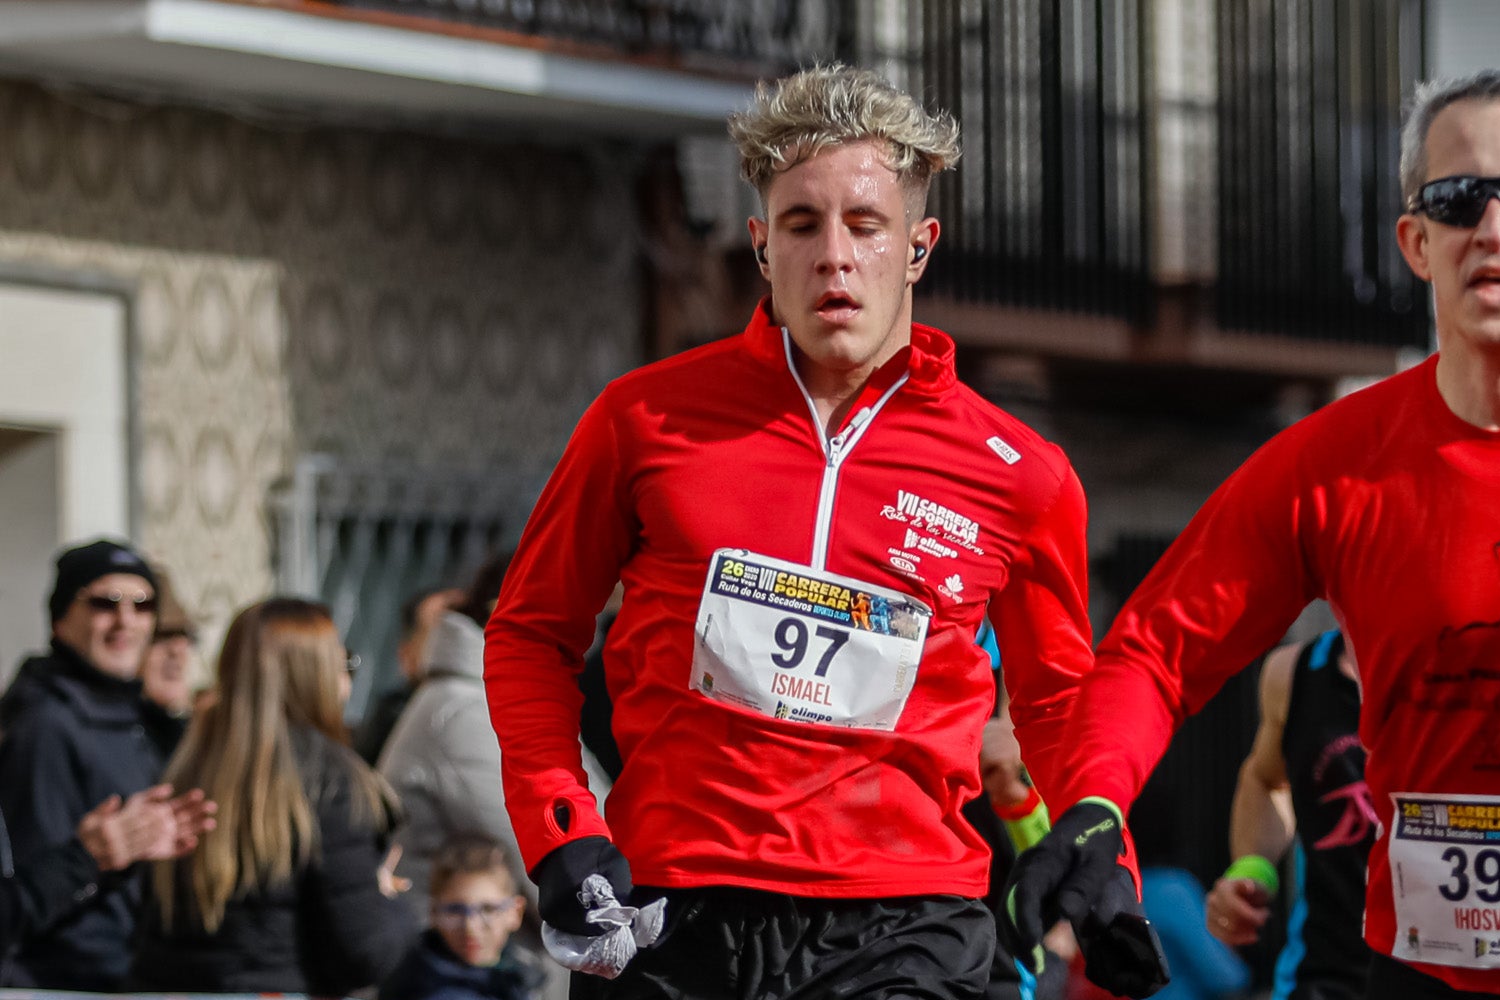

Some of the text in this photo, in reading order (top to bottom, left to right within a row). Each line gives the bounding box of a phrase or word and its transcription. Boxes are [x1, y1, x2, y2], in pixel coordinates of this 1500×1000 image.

[897, 489, 920, 517] VII
[919, 498, 979, 534] CARRERA
[880, 505, 908, 522] Ruta
[909, 516, 923, 528] de
[926, 522, 941, 536] los
[916, 507, 977, 543] POPULAR
[919, 537, 958, 559] olimpo
[722, 560, 745, 577] 26
[758, 567, 778, 592] VII
[718, 581, 813, 613] Ruta de los Secaderos
[774, 583, 849, 611] POPULAR
[777, 572, 851, 602] CARRERA
[770, 616, 849, 678] 97
[771, 672, 833, 706] ISMAEL
[791, 707, 833, 723] olimpo
[1403, 803, 1421, 817] 26
[1402, 825, 1422, 836] Ruta
[1423, 827, 1432, 836] de
